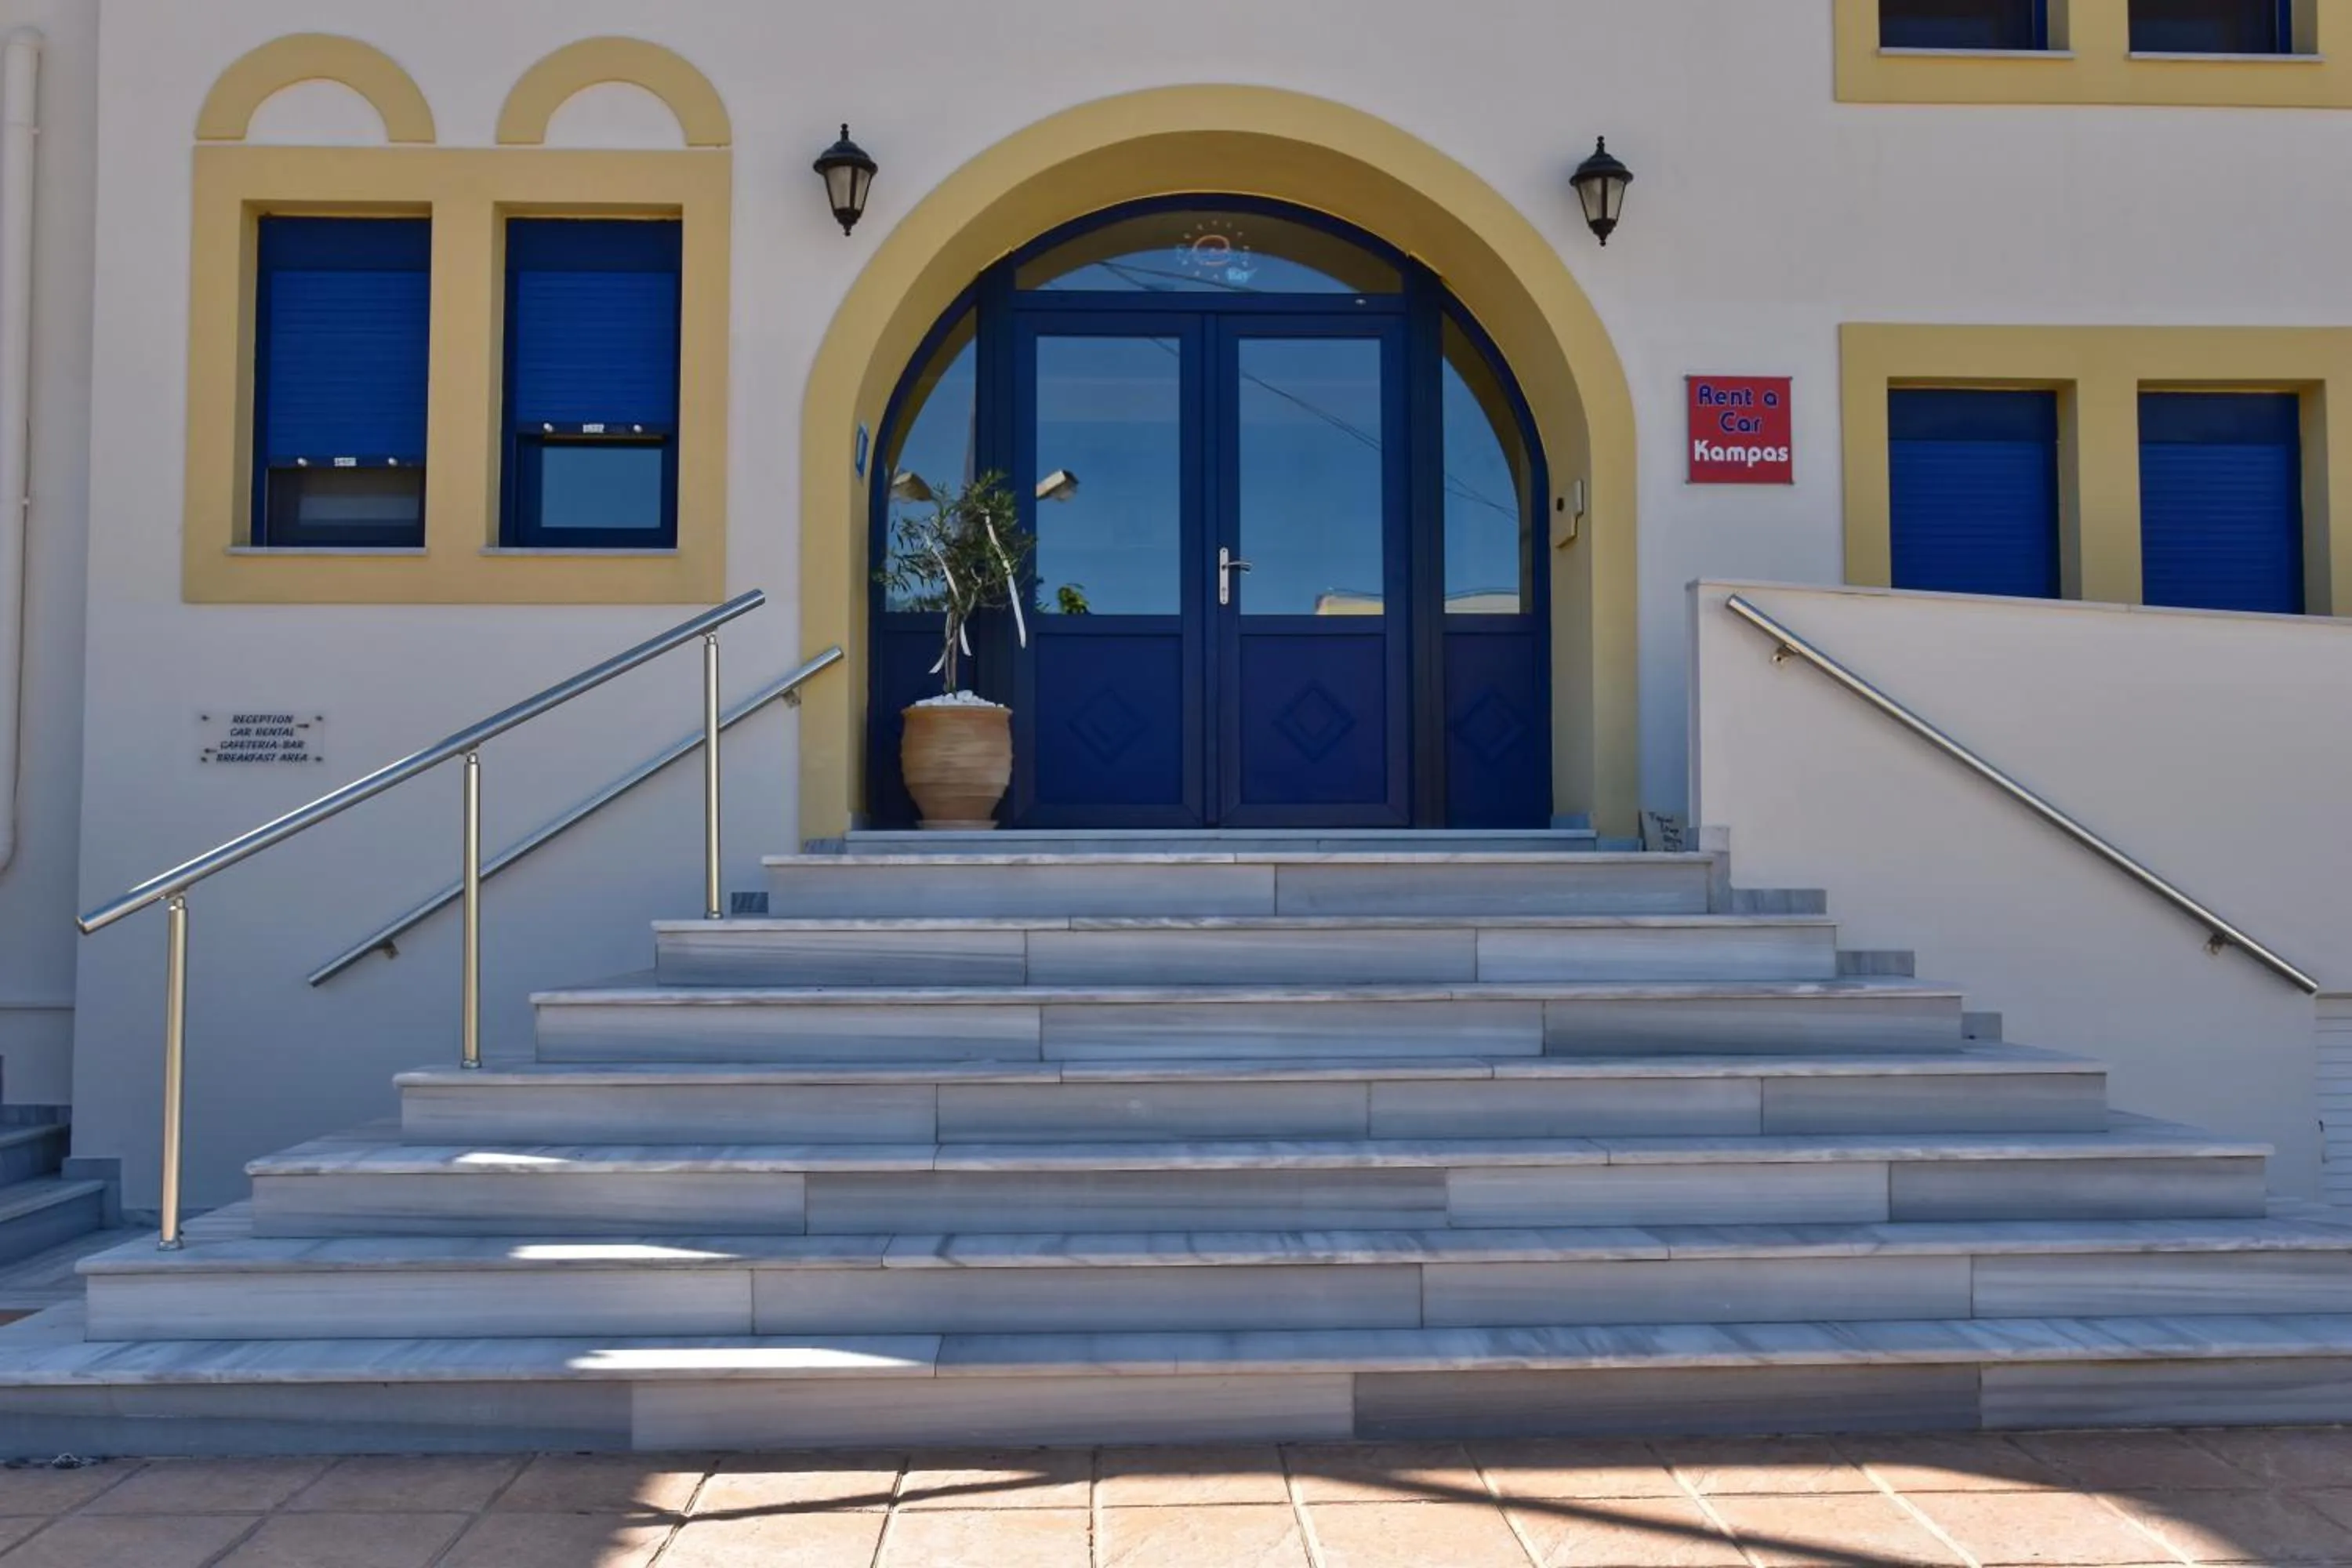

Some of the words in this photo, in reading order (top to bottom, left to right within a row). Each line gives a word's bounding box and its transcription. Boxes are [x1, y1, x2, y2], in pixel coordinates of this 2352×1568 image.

[1697, 384, 1752, 406] Rent
[1763, 390, 1778, 407] a
[1719, 411, 1762, 433] Car
[1694, 439, 1788, 468] Kampas
[232, 714, 294, 724] RECEPTION
[230, 728, 252, 737] CAR
[256, 728, 294, 737] RENTAL
[216, 753, 275, 763] BREAKFAST
[279, 753, 308, 763] AREA
